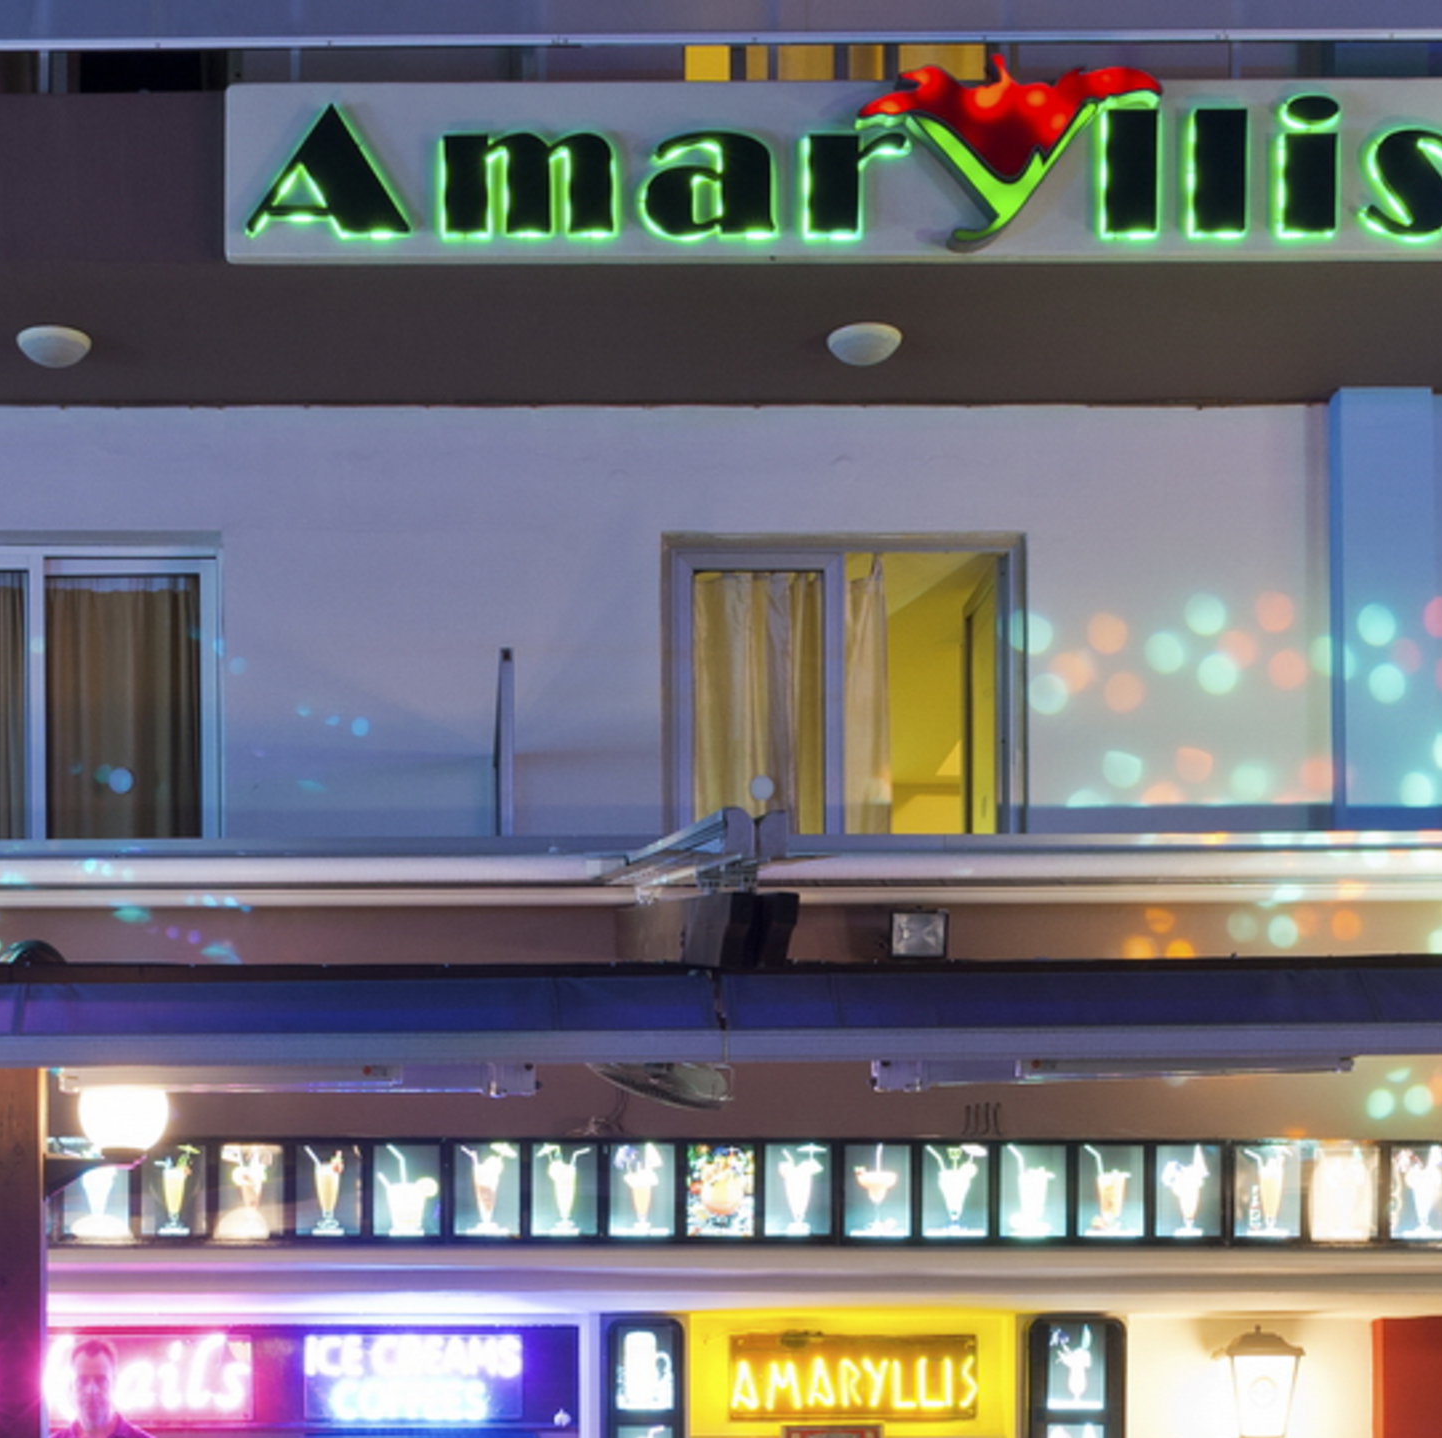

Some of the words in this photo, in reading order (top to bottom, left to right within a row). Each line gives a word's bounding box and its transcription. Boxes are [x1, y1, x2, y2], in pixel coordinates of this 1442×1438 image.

[305, 1335, 364, 1377] ICE
[370, 1335, 521, 1379] CREAMS
[730, 1355, 978, 1409] AMARYLLIS
